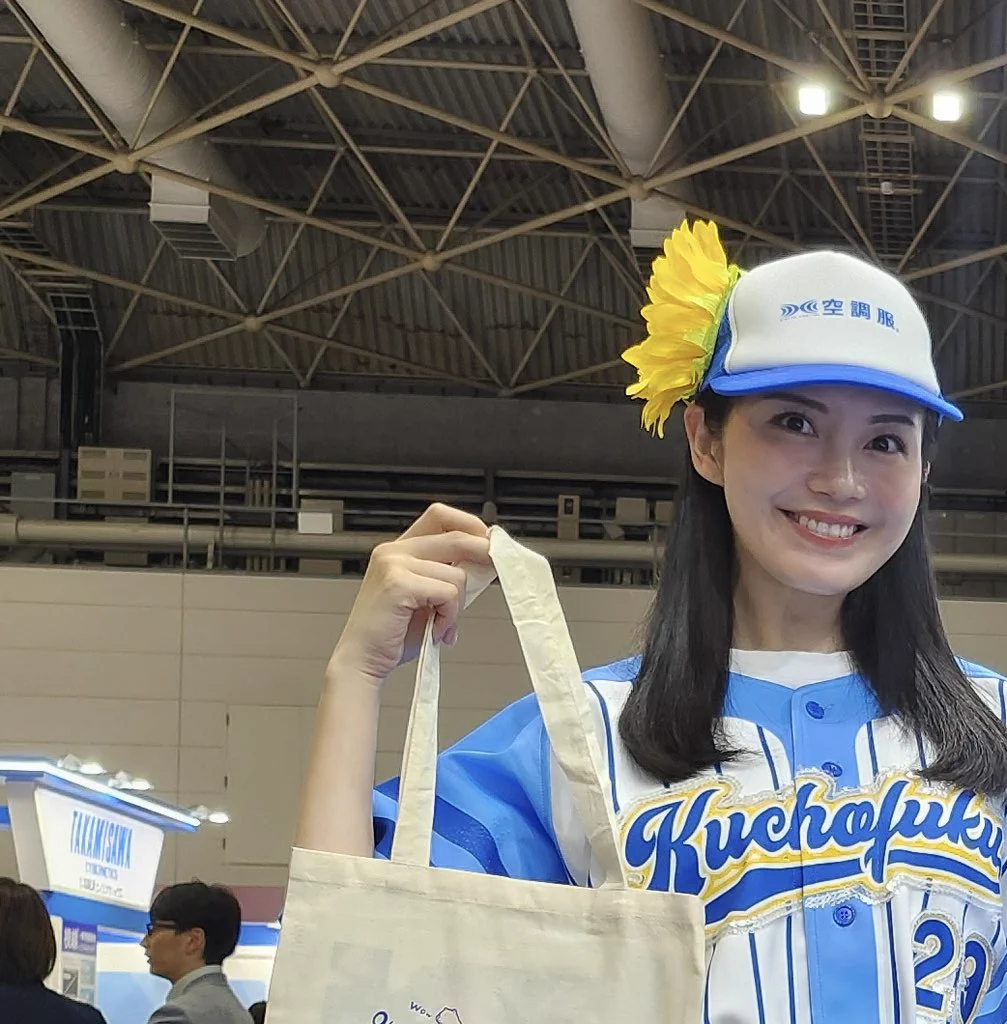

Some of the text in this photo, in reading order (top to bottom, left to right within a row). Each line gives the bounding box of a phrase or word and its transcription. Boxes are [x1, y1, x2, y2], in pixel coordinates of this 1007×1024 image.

[822, 298, 897, 331] 空調服
[624, 779, 1003, 896] Kuchofuku
